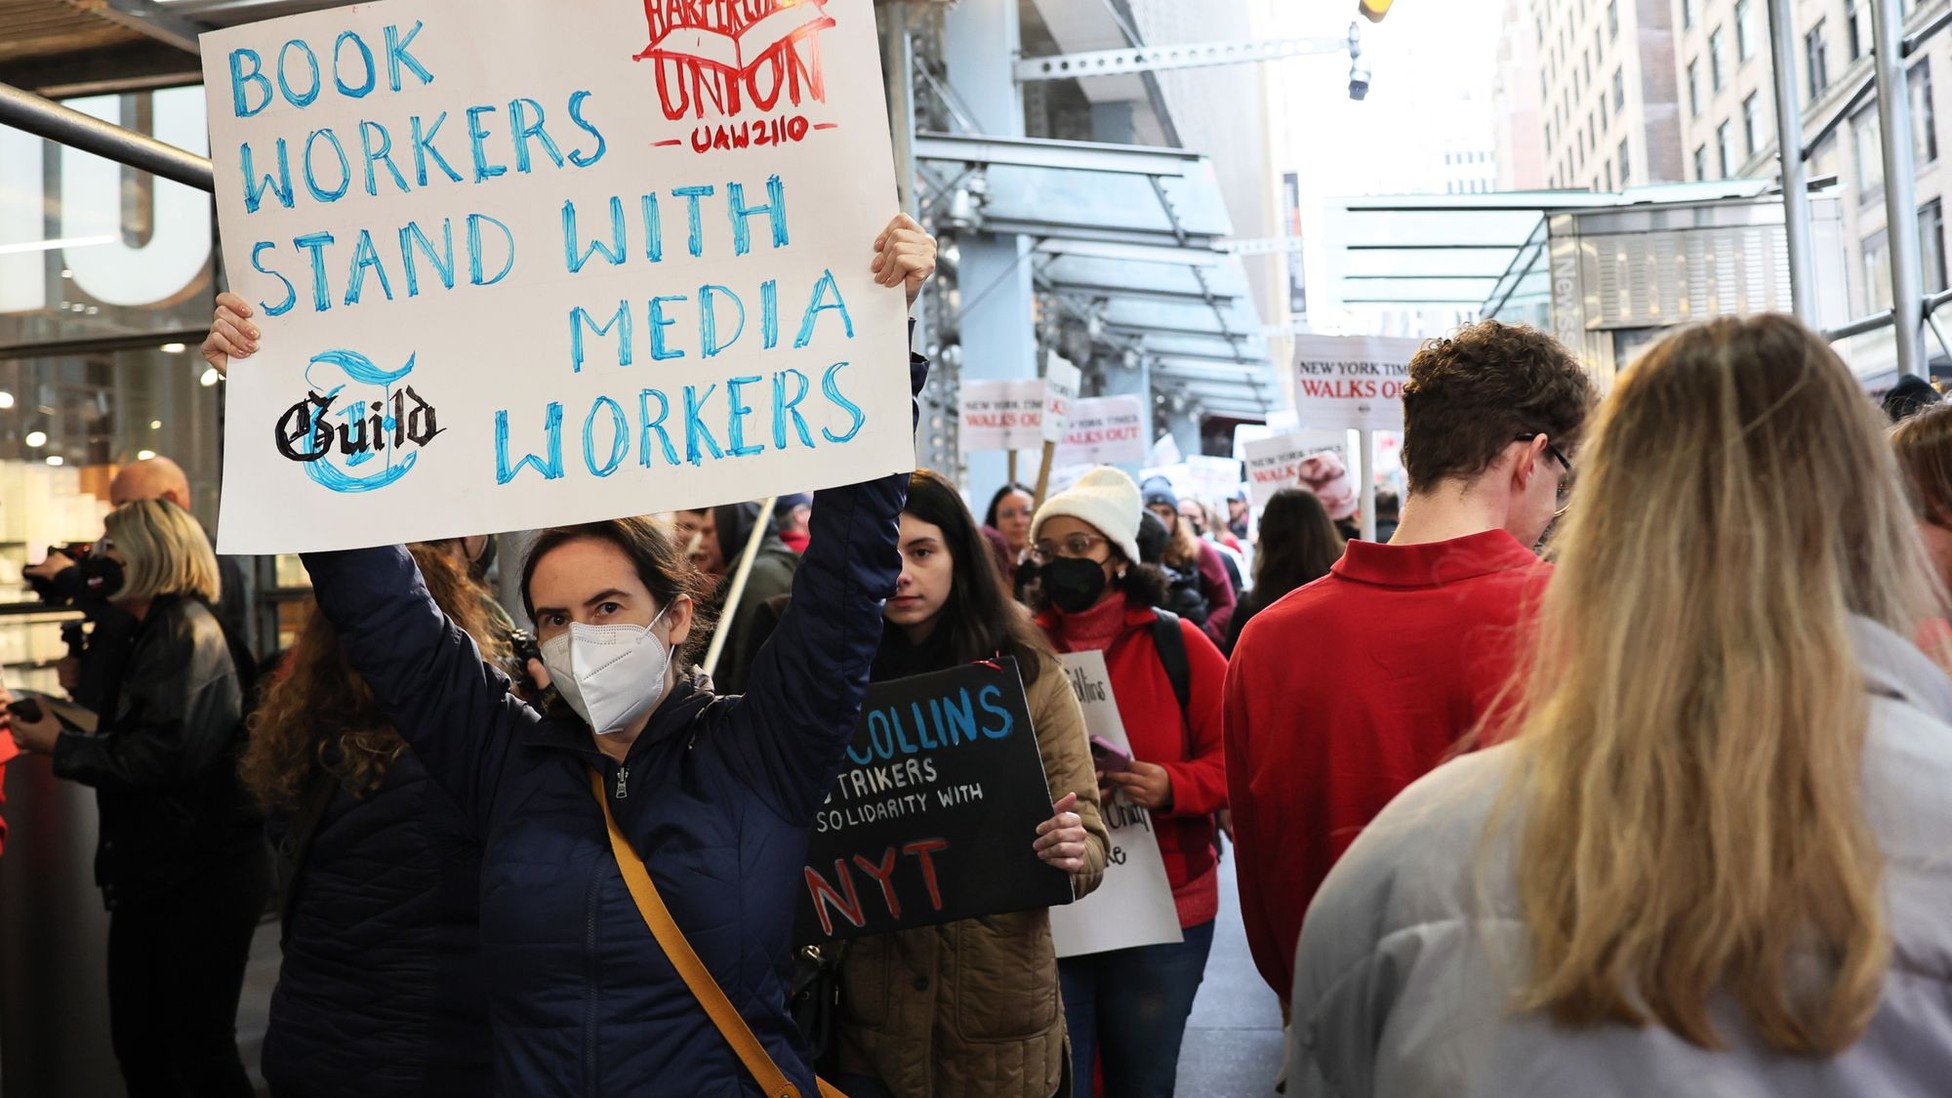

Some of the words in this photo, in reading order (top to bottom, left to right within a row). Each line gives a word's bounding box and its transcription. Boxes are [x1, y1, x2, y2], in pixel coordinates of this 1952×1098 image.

[229, 21, 434, 118] BOOK
[653, 34, 826, 121] UNION
[240, 90, 607, 214] WORKERS
[251, 213, 515, 317] STAND
[561, 175, 790, 274] WITH
[569, 269, 855, 373] MEDIA
[1300, 362, 1335, 375] NEW
[1338, 362, 1380, 375] YORK
[1301, 379, 1377, 398] WALKS
[275, 385, 448, 462] Guild
[495, 361, 866, 486] WORKERS
[967, 413, 1017, 426] WALKS
[1106, 425, 1138, 440] OUT
[816, 793, 927, 833] SOLIDARITY
[937, 782, 984, 808] WITH
[824, 757, 937, 804] TRIKERS
[804, 837, 948, 937] NYT
